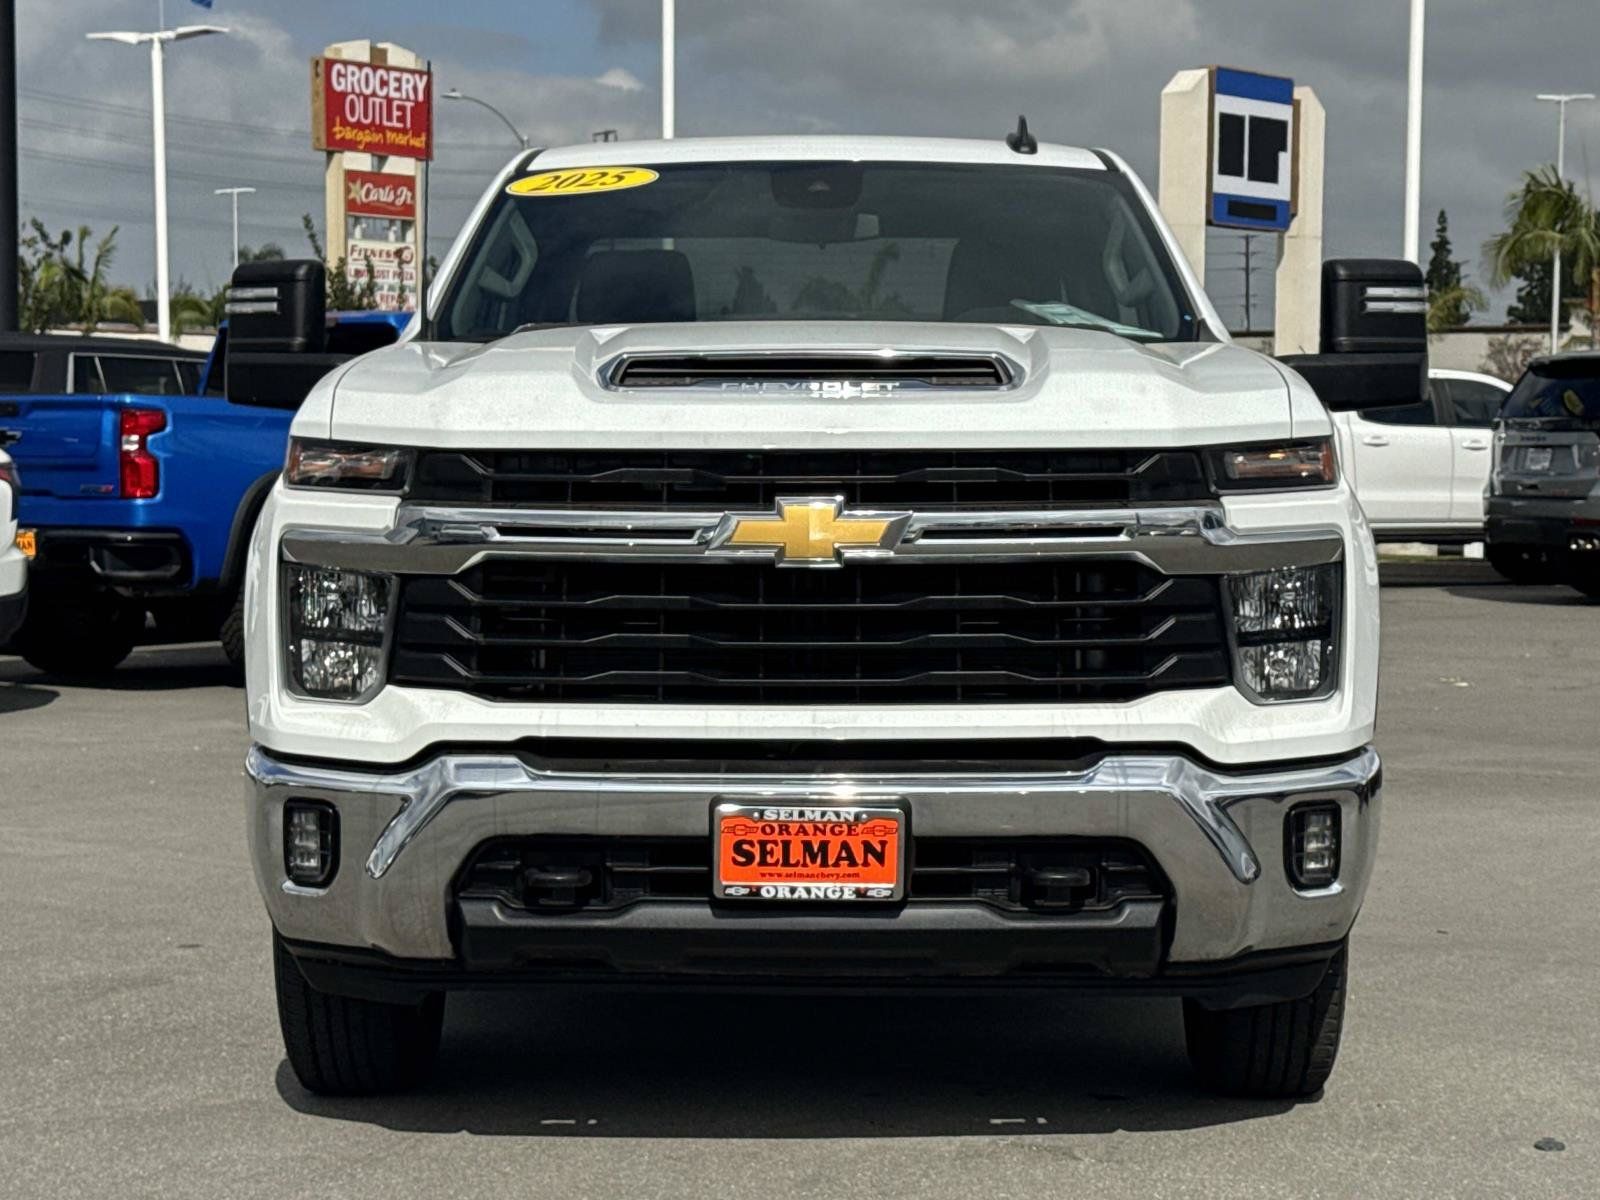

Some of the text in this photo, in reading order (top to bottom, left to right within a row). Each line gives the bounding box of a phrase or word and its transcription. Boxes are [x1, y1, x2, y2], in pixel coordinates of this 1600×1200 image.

[331, 63, 428, 102] GROCERY
[345, 94, 415, 129] OUTLET
[332, 116, 426, 149] bargain market
[527, 171, 636, 192] 2025
[361, 182, 395, 204] Carl's
[721, 380, 900, 392] CHEVROLET
[763, 808, 857, 822] SELMAN
[760, 823, 861, 837] ORANGE
[731, 838, 889, 868] SELMAN
[759, 871, 860, 880] www.selmanchevy.com
[760, 885, 857, 899] ORANGE
